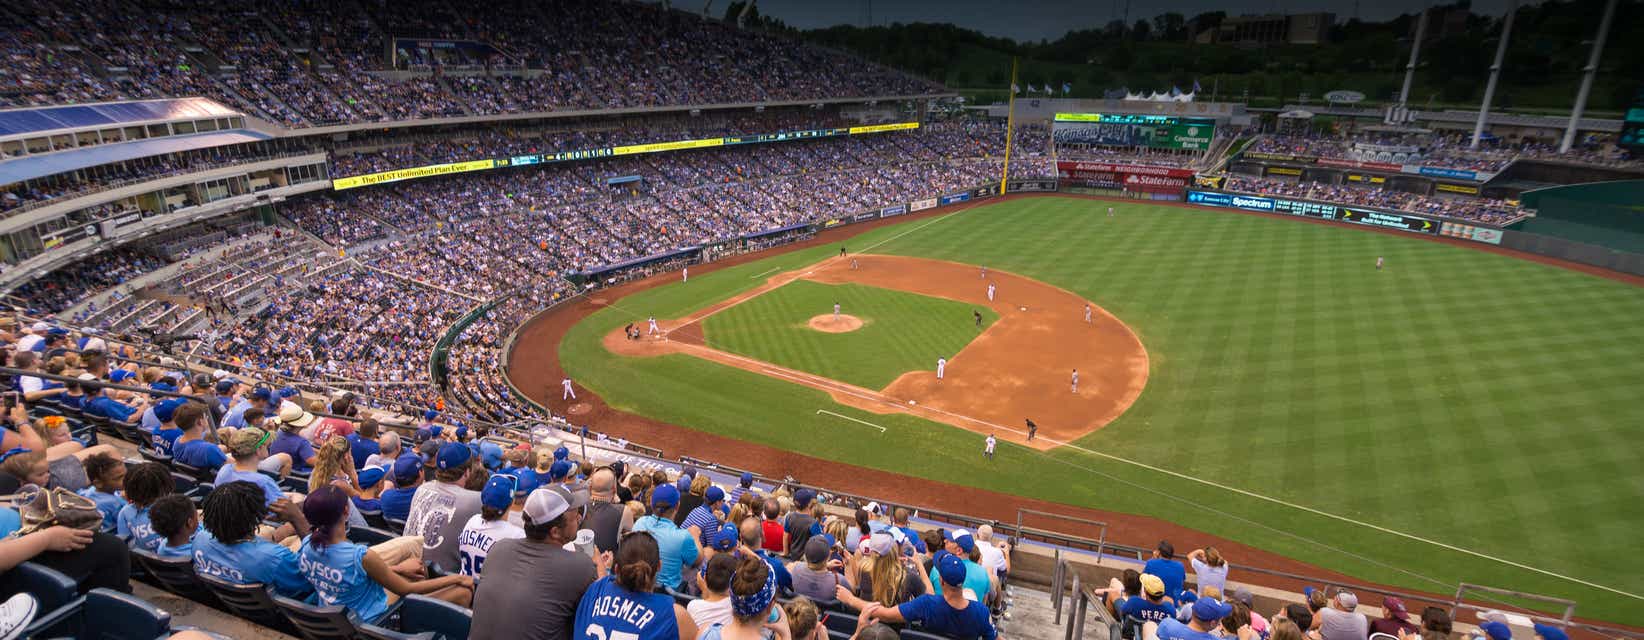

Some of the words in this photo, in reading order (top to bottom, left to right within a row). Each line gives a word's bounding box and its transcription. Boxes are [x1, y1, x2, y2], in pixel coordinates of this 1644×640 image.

[1174, 135, 1209, 143] Commerce
[377, 173, 396, 181] BEST
[434, 164, 450, 173] Plan
[451, 161, 467, 170] Ever
[1115, 166, 1169, 175] NEIGHBORHOOD
[1232, 197, 1272, 209] Spectrum
[591, 596, 655, 630] HOSMER
